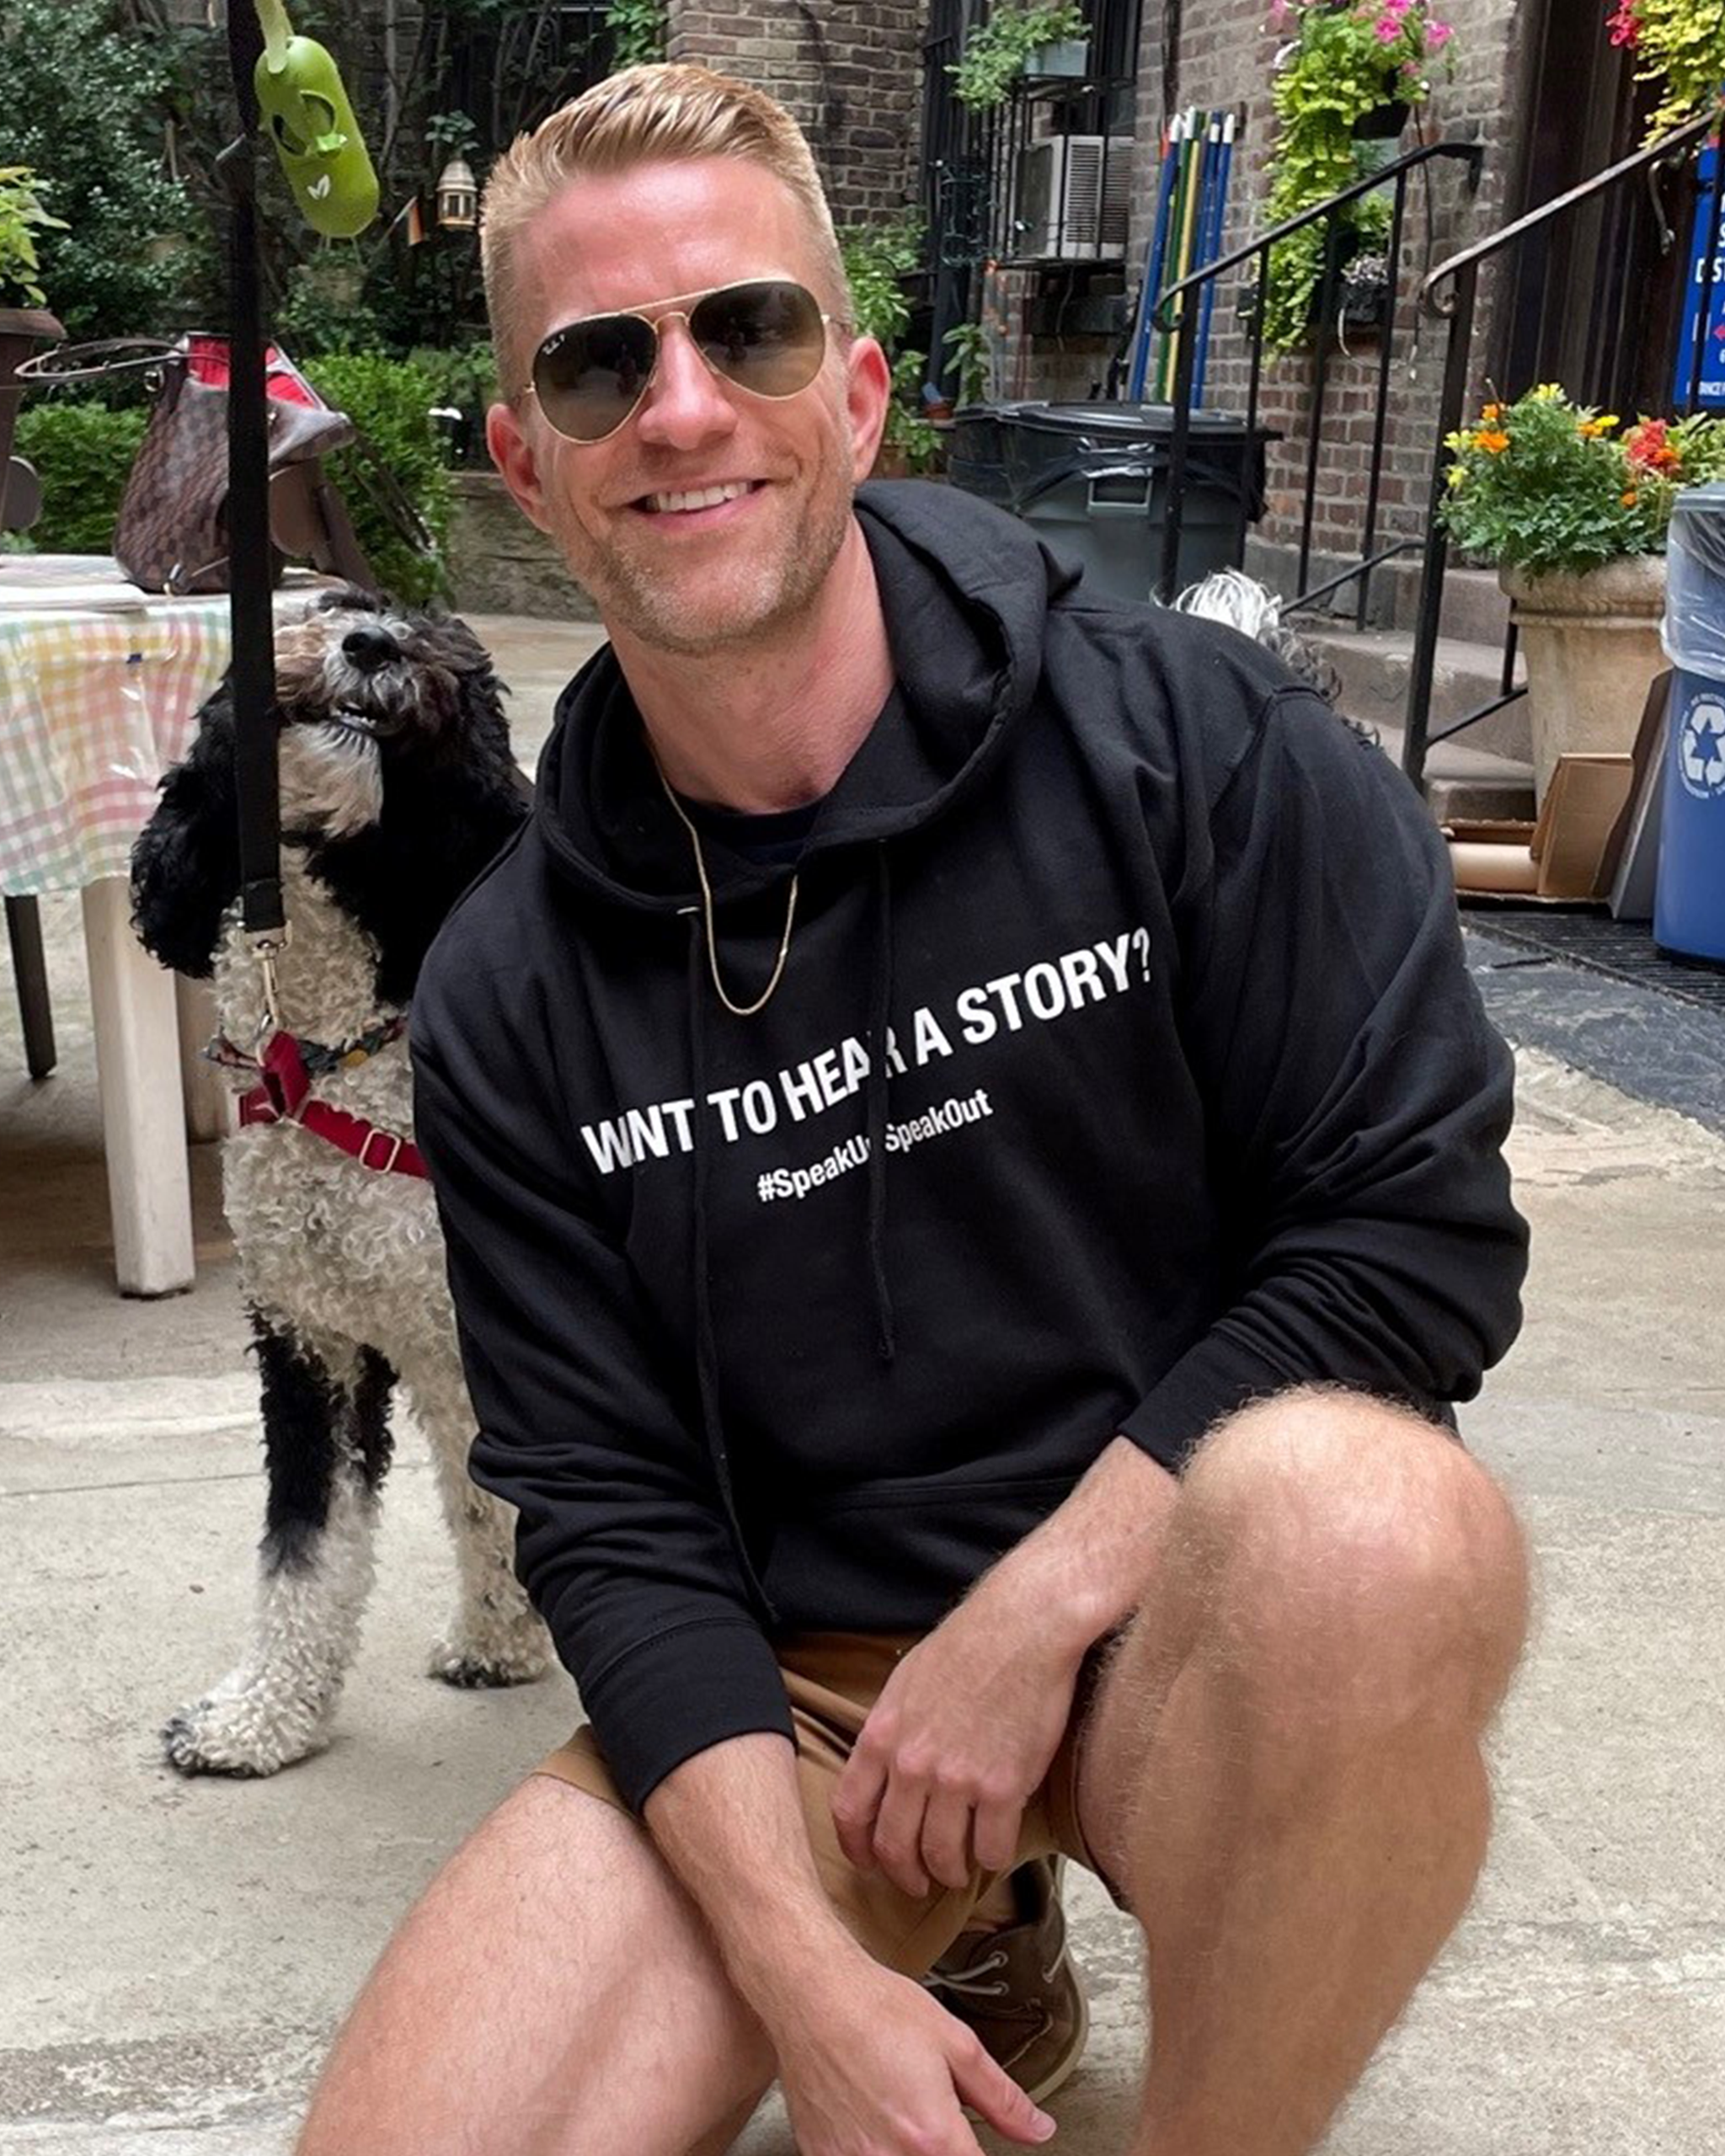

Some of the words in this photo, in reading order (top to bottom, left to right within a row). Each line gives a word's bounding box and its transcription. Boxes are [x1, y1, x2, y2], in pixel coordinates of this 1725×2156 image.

[706, 1087, 778, 1143] TO
[914, 1006, 953, 1067] A
[956, 927, 1151, 1044] STORY?
[757, 1134, 872, 1203] #SpeakU
